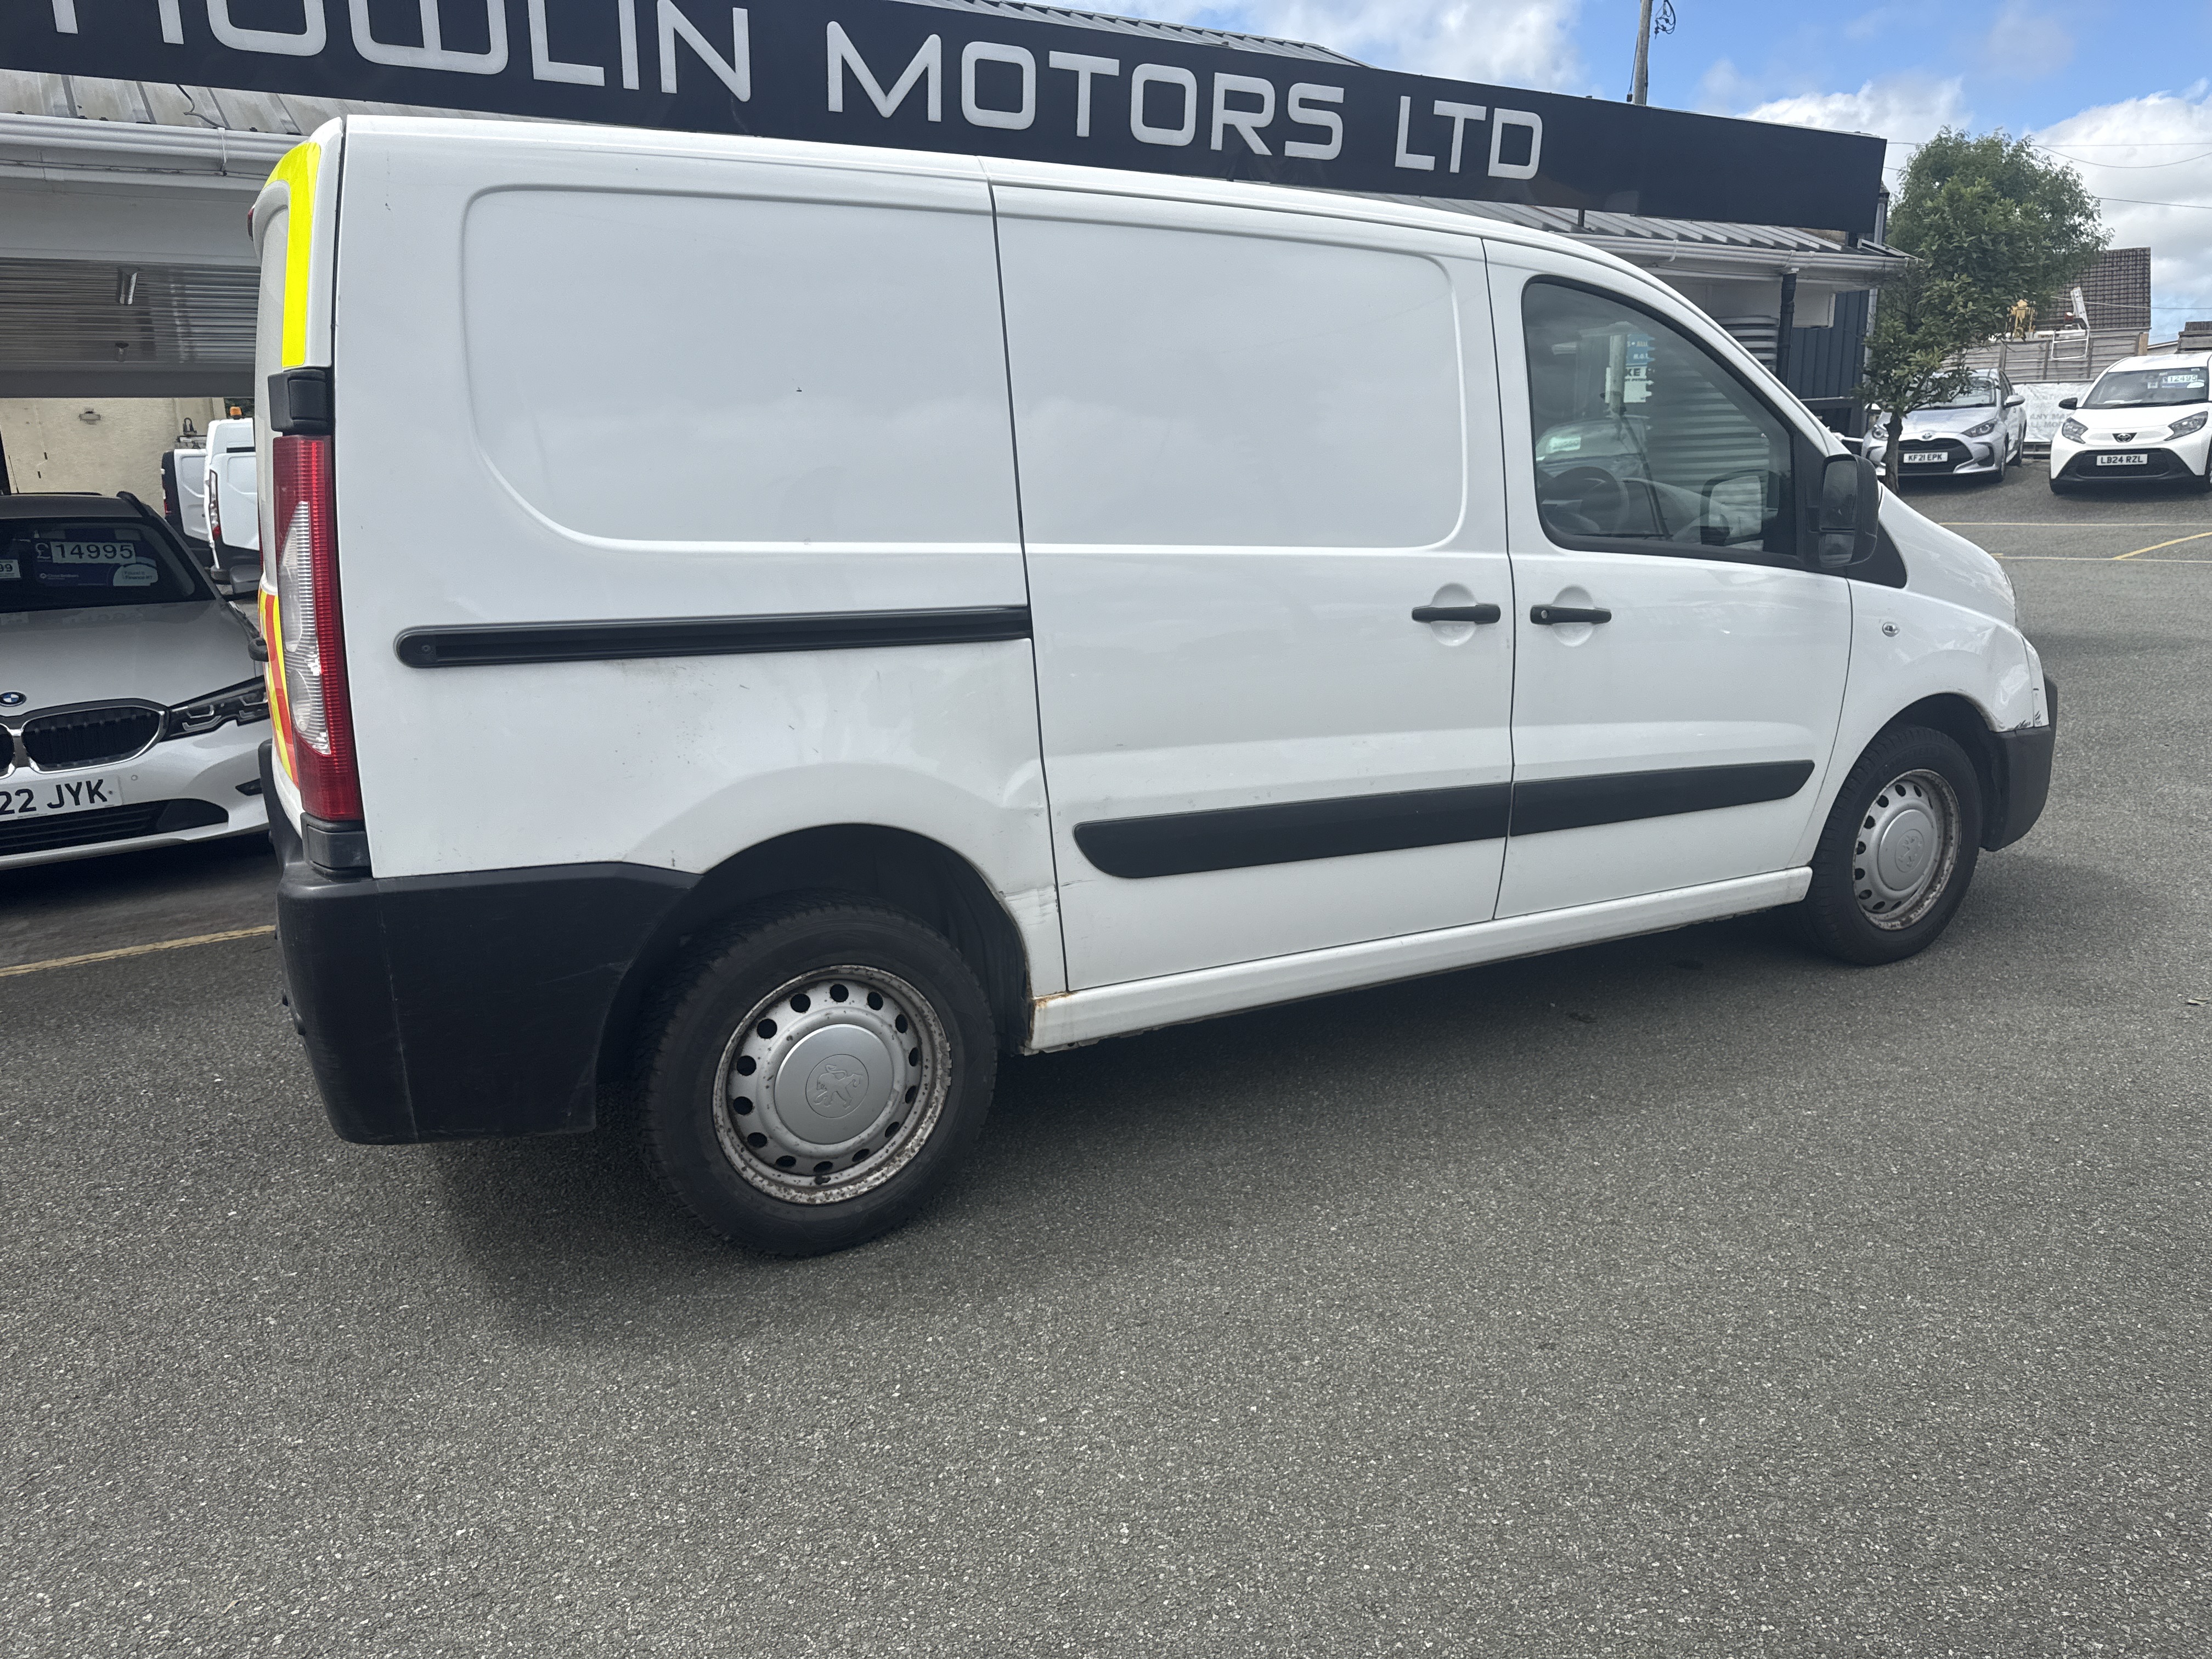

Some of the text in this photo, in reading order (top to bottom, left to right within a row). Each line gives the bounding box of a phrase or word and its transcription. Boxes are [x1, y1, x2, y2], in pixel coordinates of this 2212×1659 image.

[826, 21, 1345, 161] MOTORS
[1394, 95, 1544, 180] LTD
[2101, 456, 2124, 464] LB24
[0, 779, 108, 815] 22 JYK
